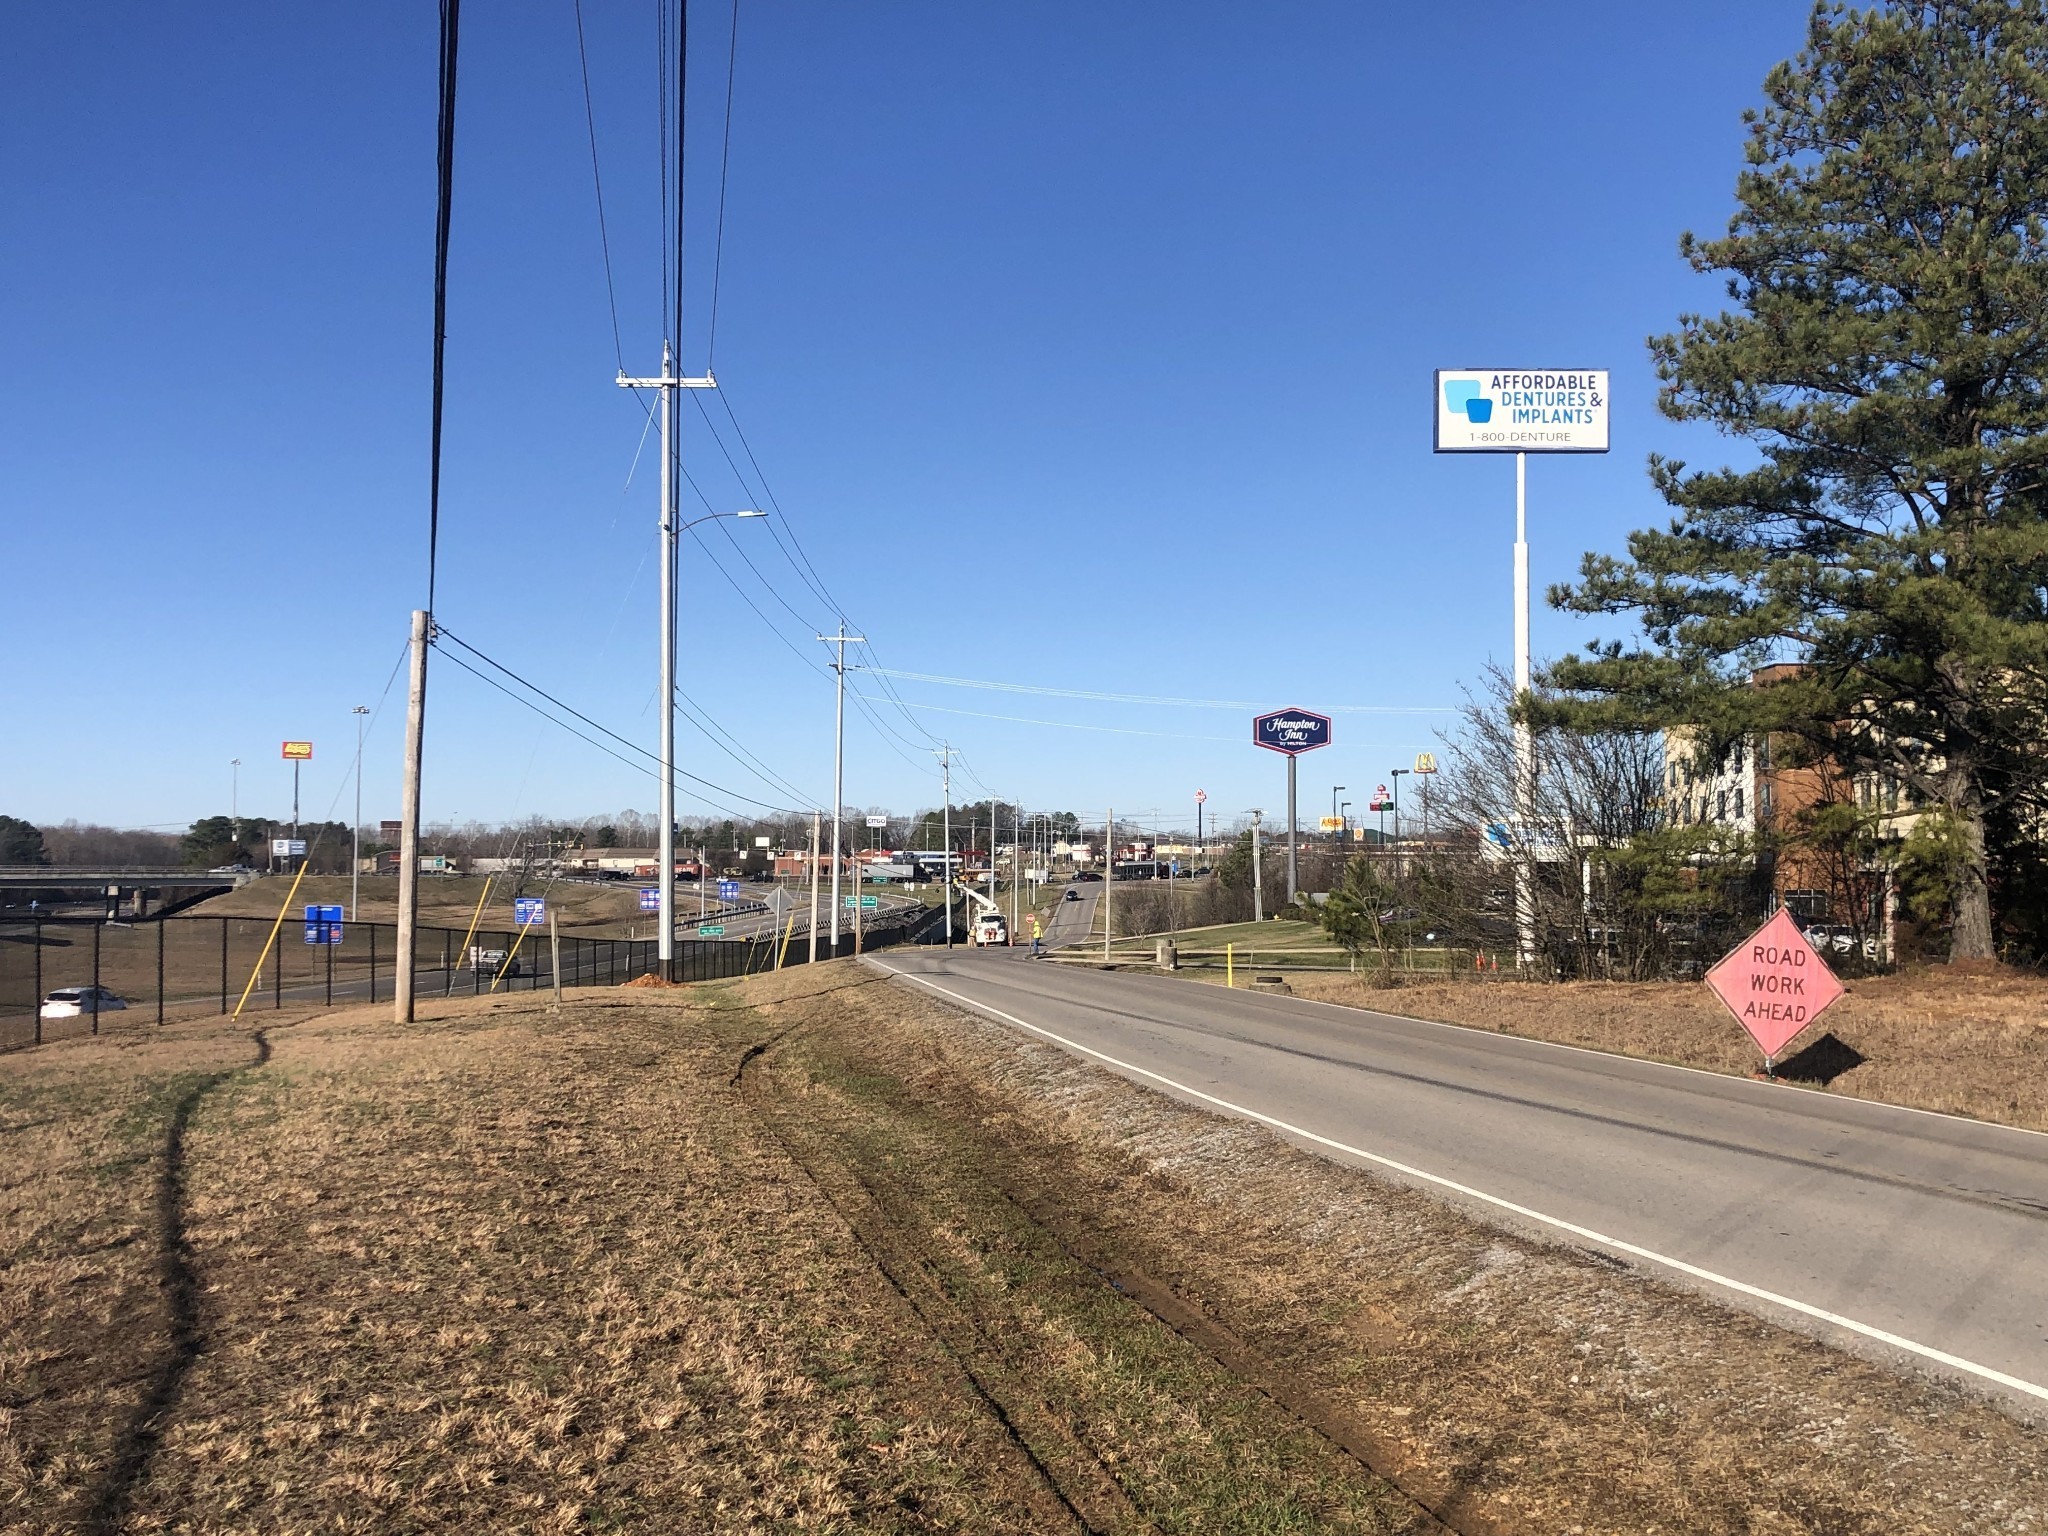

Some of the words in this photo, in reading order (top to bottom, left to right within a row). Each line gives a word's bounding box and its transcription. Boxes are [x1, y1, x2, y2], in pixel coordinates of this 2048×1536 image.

[1491, 374, 1596, 390] AFFORDABLE
[1502, 391, 1586, 407] DENTURES
[1590, 392, 1603, 407] &
[1512, 408, 1593, 424] IMPLANTS
[1470, 432, 1572, 442] 1-800-DENTURE
[1266, 717, 1320, 732] Hampton
[1279, 729, 1308, 741] Inn
[1753, 946, 1806, 967] ROAD
[1751, 973, 1805, 996] WORK
[1743, 1001, 1806, 1022] AHEAD
